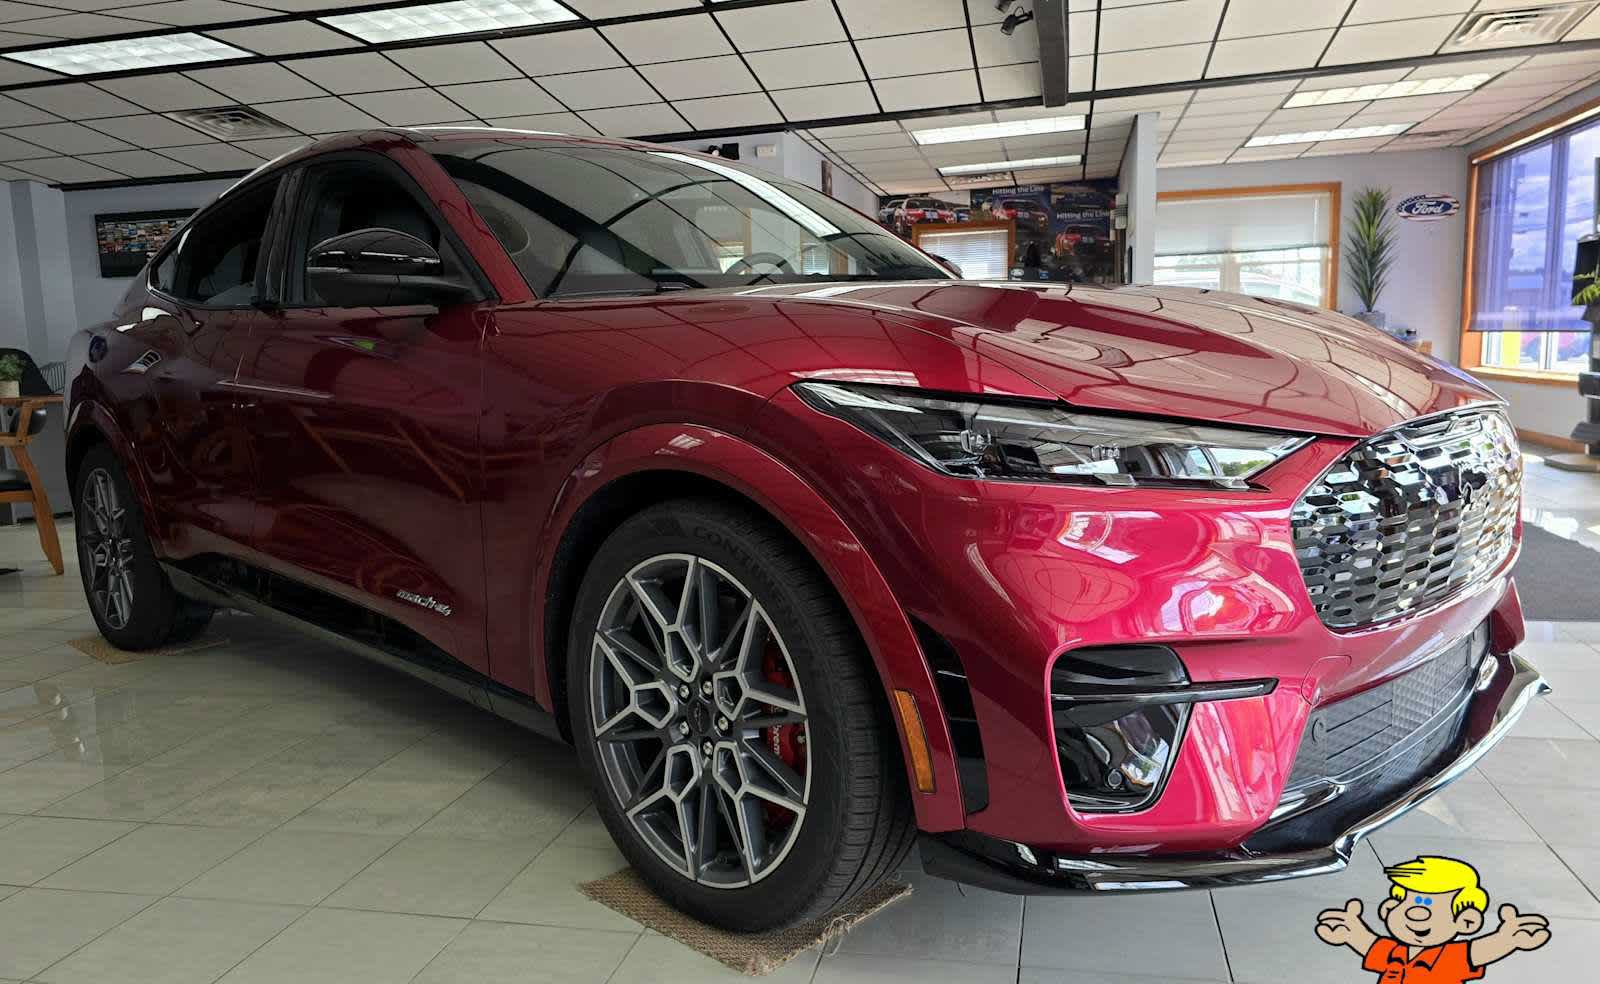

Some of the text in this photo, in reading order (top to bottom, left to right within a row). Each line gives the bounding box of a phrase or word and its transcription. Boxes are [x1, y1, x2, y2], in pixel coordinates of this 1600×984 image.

[992, 184, 1044, 195] Hitting the Line
[1411, 201, 1445, 214] Ford
[1056, 211, 1081, 220] Hitting
[1082, 210, 1094, 218] the
